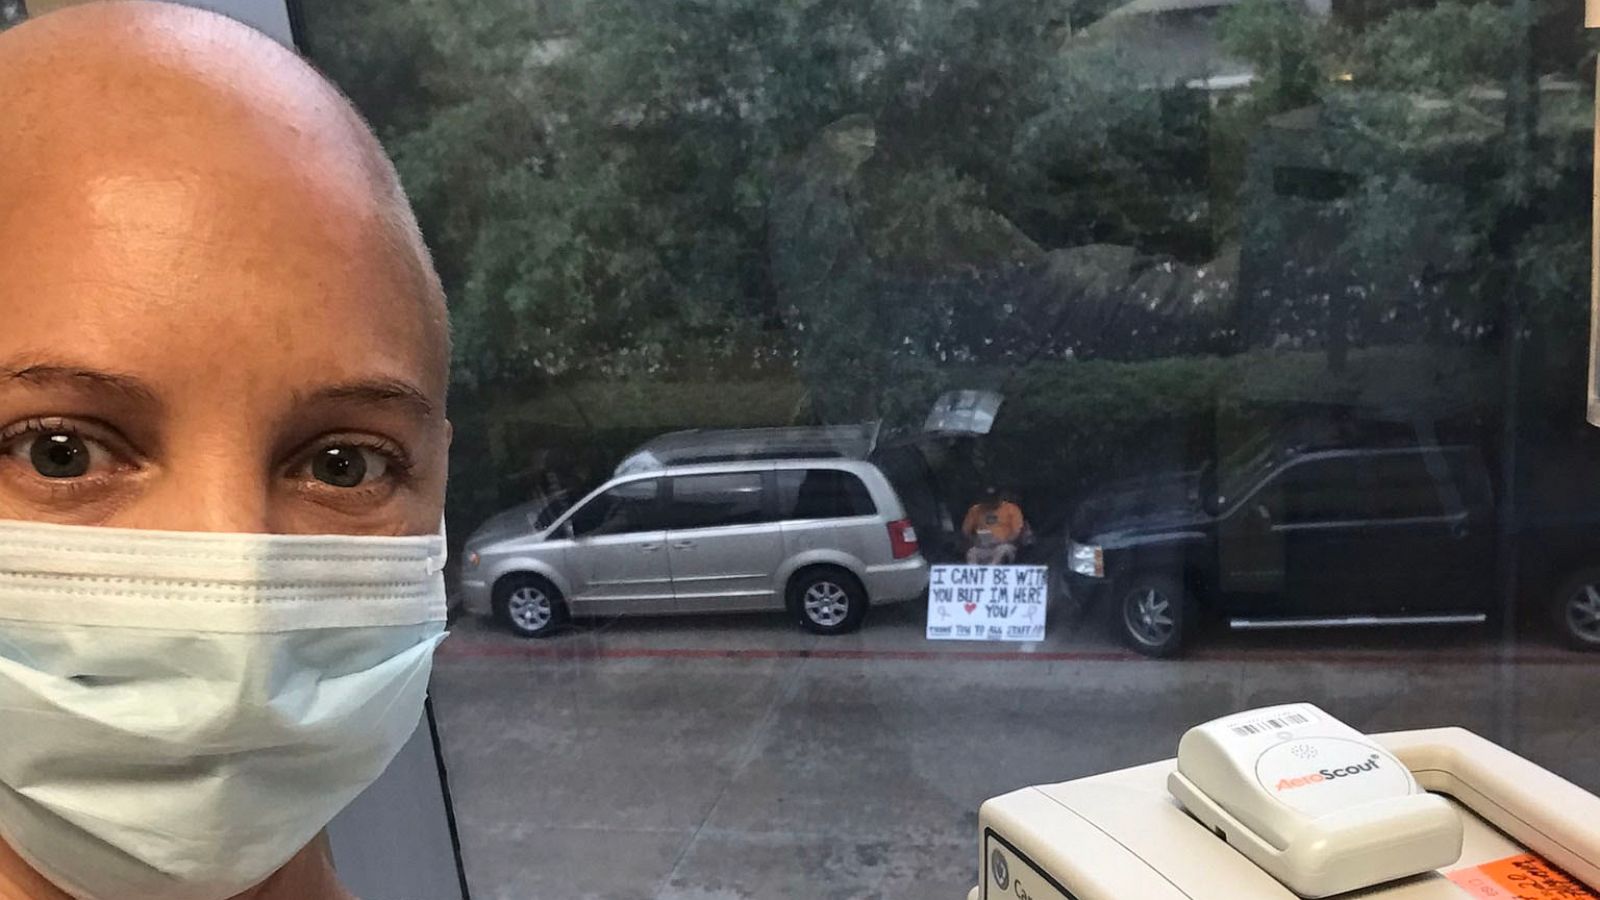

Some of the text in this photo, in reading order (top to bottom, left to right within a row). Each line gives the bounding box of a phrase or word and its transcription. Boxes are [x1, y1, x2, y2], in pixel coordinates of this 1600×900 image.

[932, 568, 947, 585] I
[951, 567, 989, 585] CANT
[993, 568, 1011, 585] BE
[932, 586, 1044, 605] YOU BUT IM HERE
